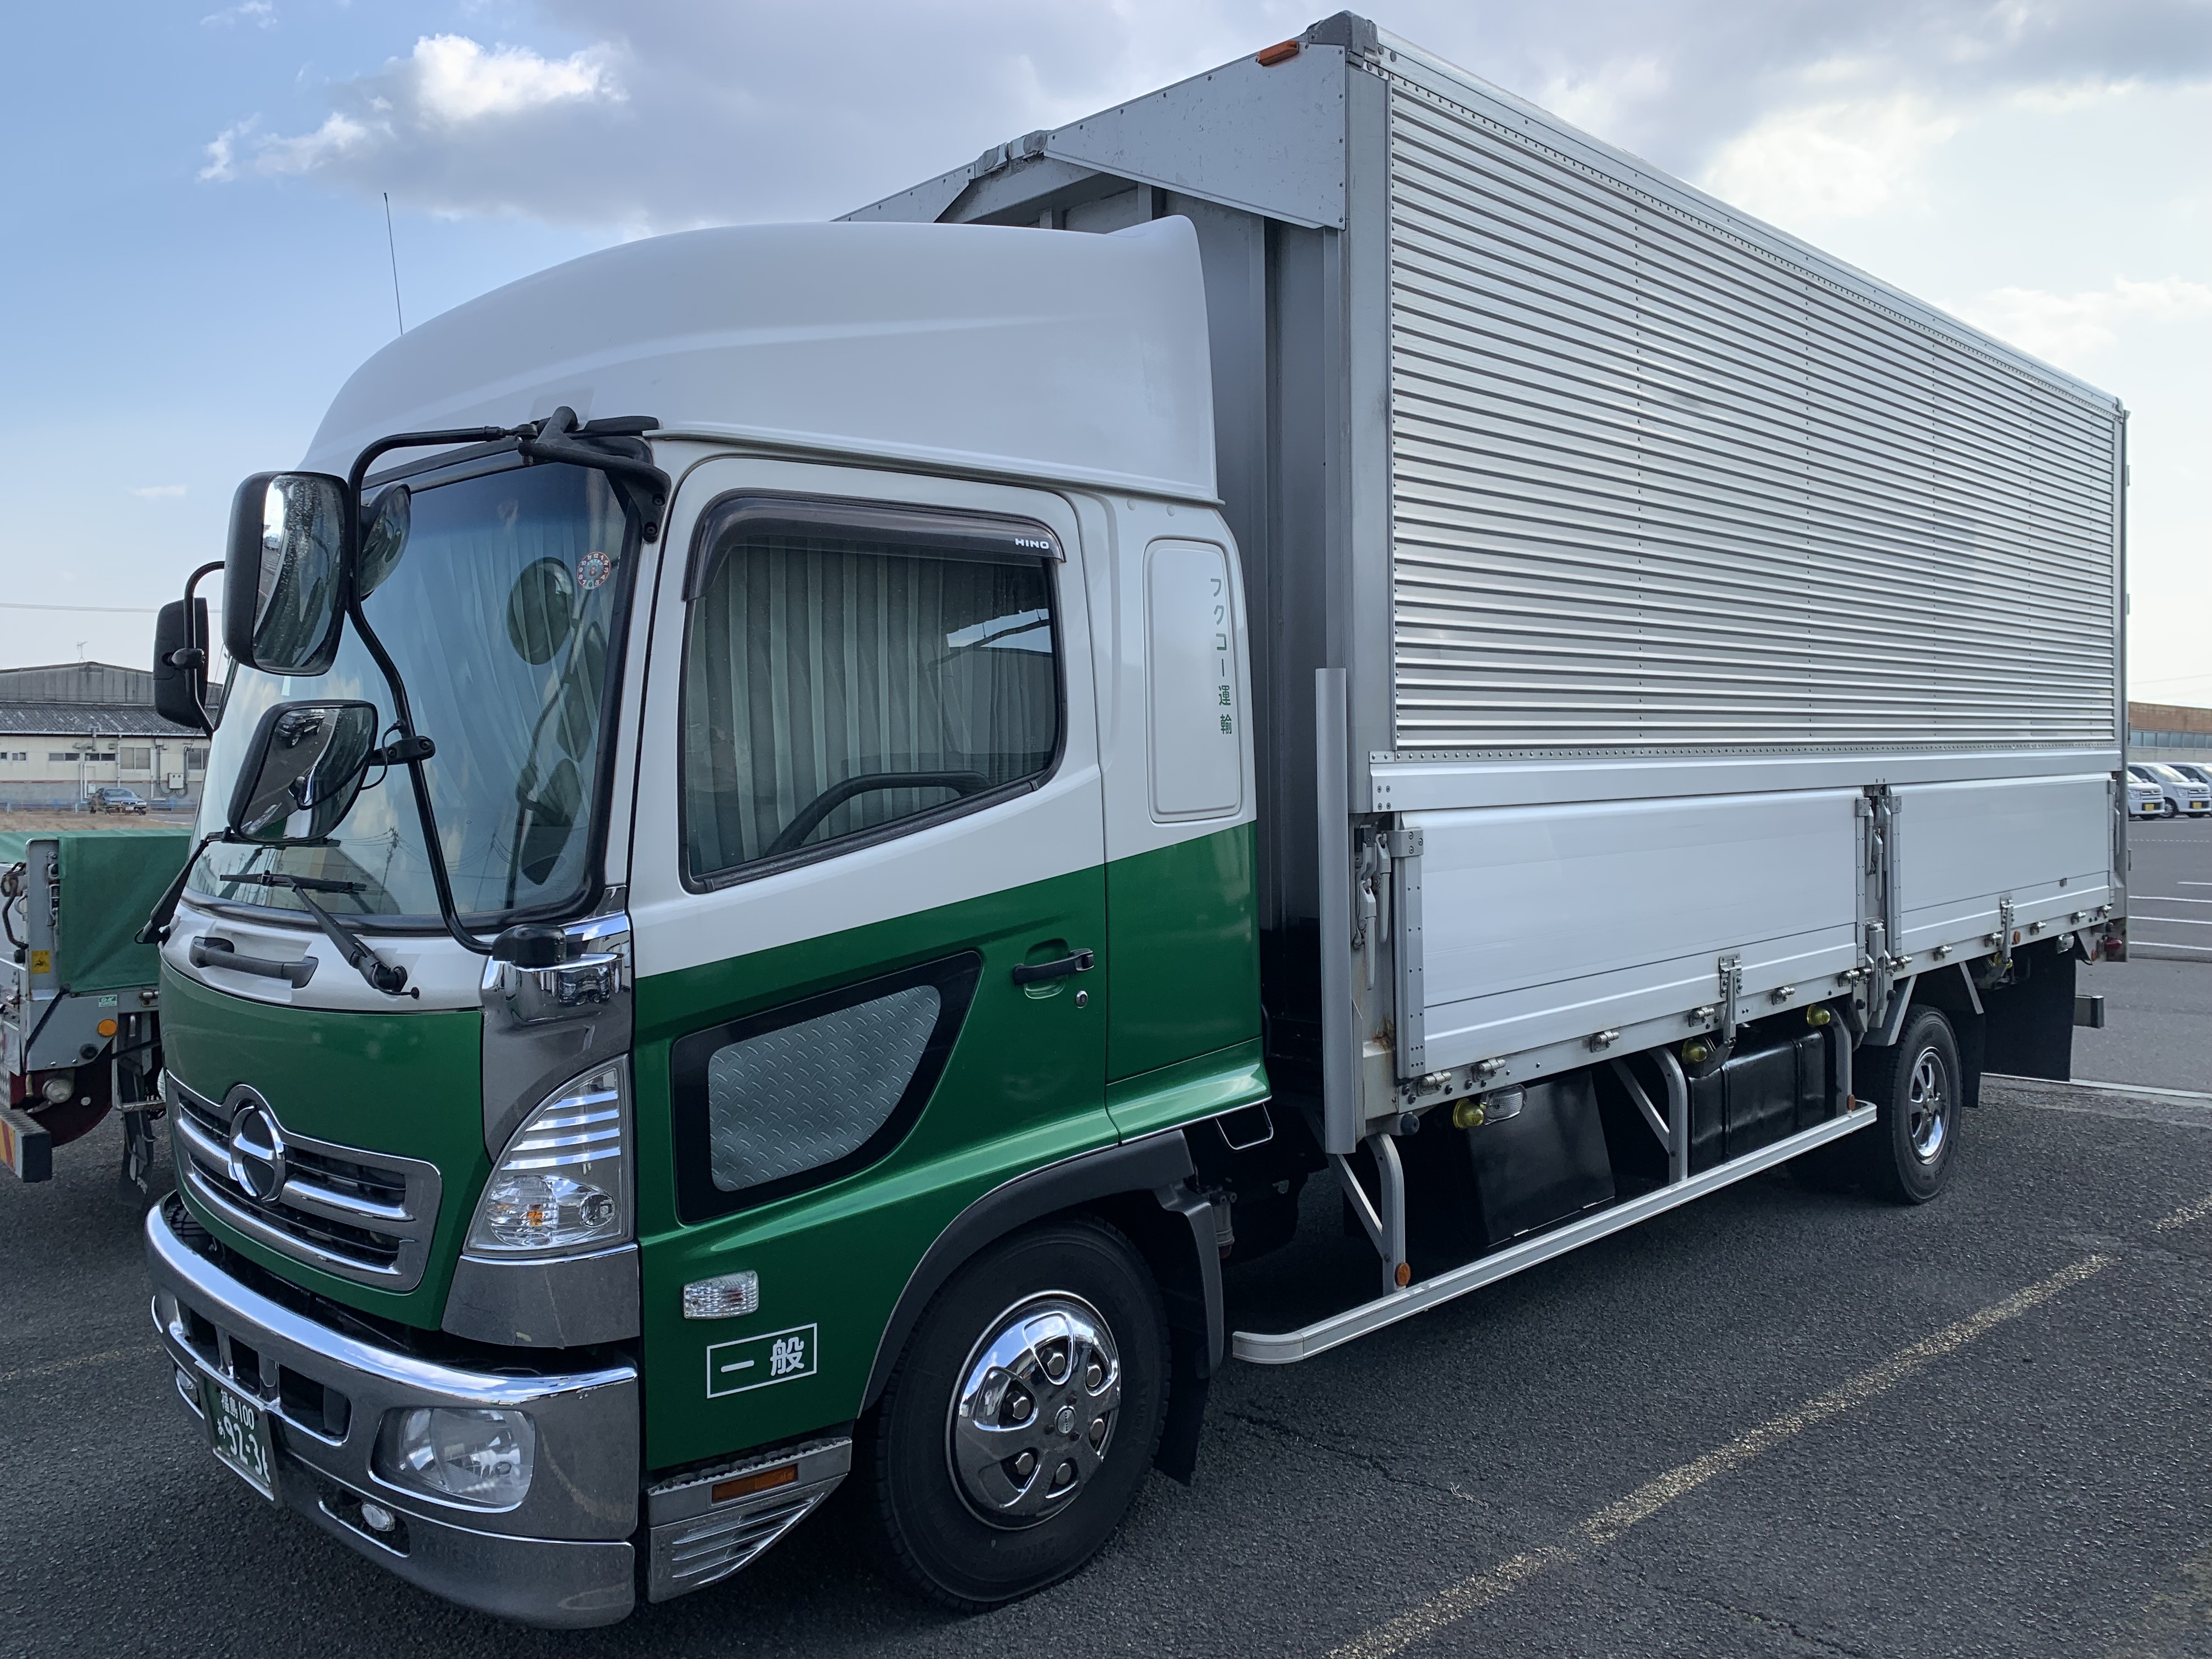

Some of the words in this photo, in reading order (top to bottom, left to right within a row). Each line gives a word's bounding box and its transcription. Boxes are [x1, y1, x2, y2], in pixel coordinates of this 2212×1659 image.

[1015, 538, 1049, 549] HINO
[1210, 578, 1232, 735] フクコー運輸
[720, 1336, 805, 1376] 一般
